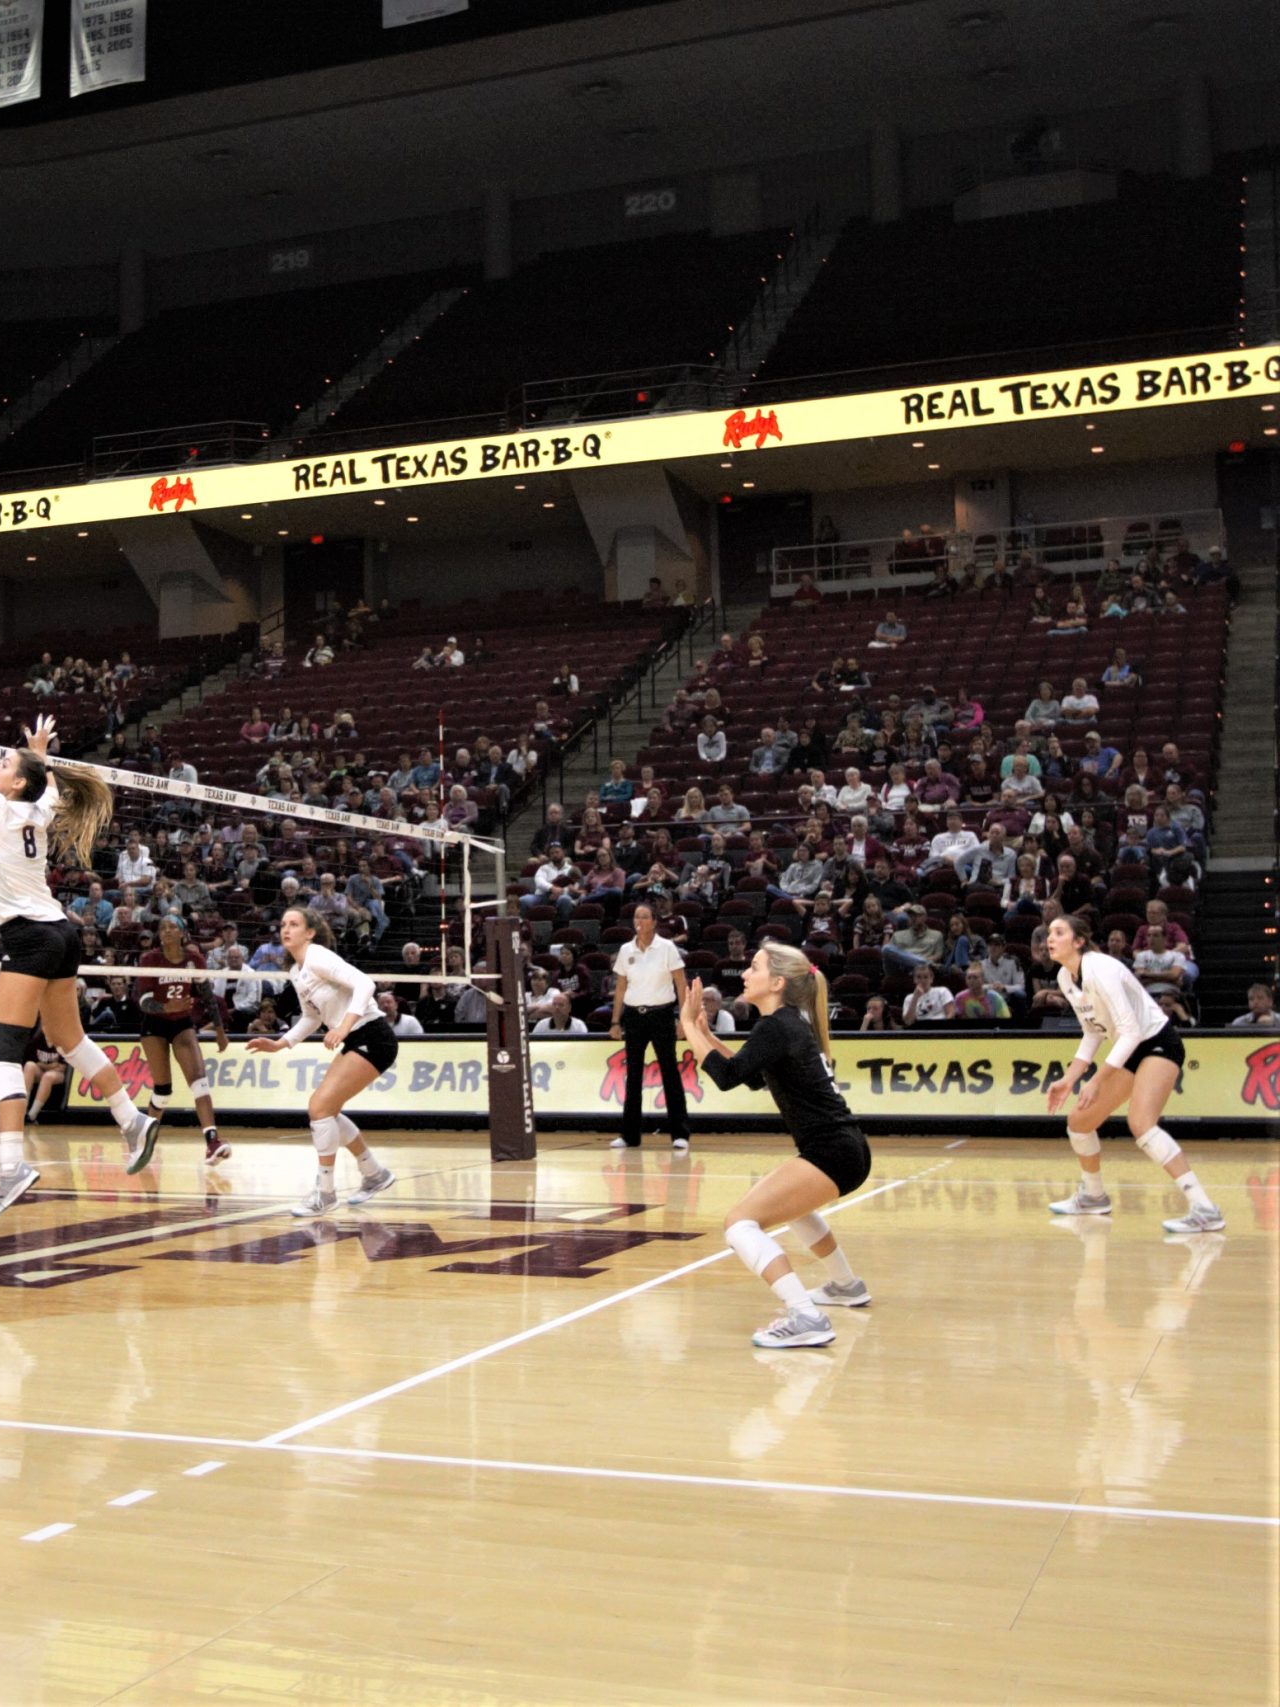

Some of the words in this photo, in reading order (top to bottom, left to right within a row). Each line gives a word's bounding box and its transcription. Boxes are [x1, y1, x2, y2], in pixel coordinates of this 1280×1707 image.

[110, 8, 134, 22] 1982
[624, 189, 676, 216] 220
[270, 249, 310, 272] 219
[901, 388, 994, 424] REAL
[999, 373, 1120, 414] TEXAS
[293, 459, 366, 491] REAL
[372, 447, 467, 483] TEXAS
[480, 434, 601, 472] BAR-B-Q
[133, 774, 155, 787] TEXAS
[204, 788, 224, 800] TEXAS
[268, 800, 286, 812] TEXAS
[22, 825, 36, 858] 8
[167, 985, 184, 998] 22
[204, 1058, 280, 1089] REAL
[857, 1058, 994, 1094] TEXAS
